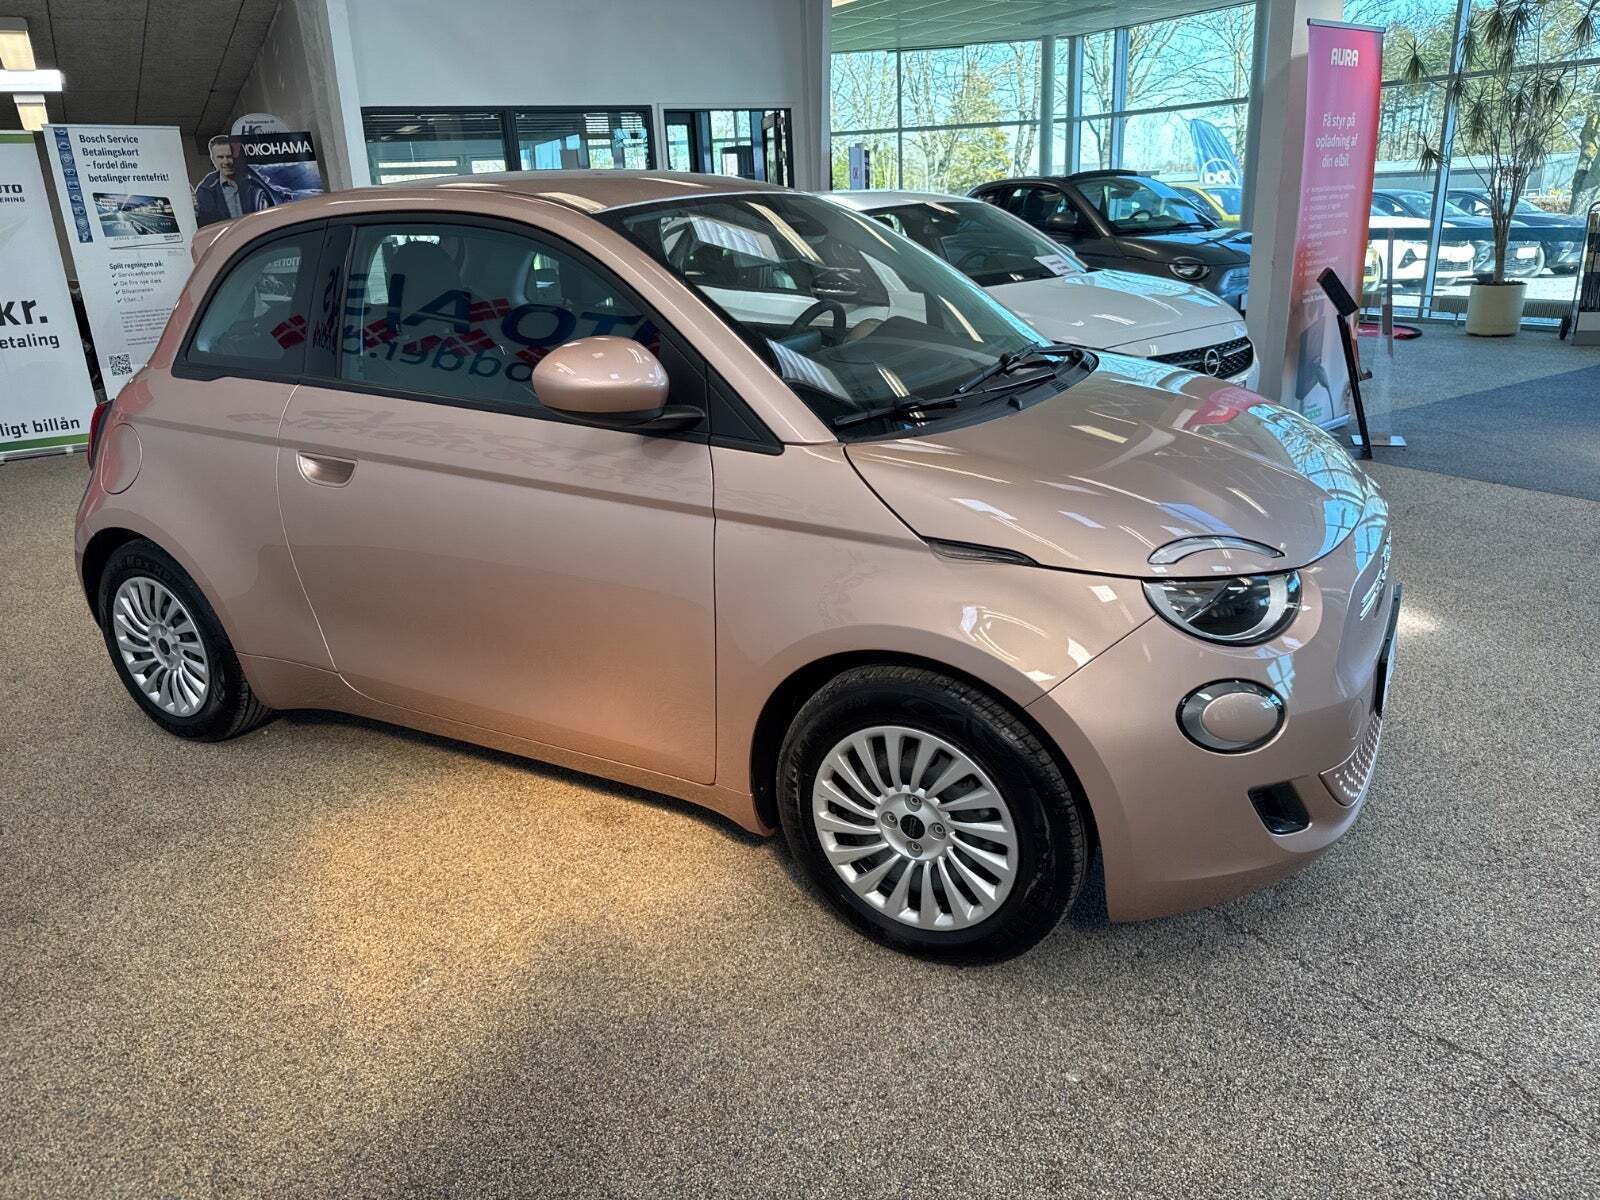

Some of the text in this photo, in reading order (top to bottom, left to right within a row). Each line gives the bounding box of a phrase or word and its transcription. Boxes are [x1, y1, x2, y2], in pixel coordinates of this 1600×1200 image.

[1330, 47, 1359, 67] AURA
[79, 134, 139, 144] Bosch Service
[82, 147, 140, 158] Betalingskort
[241, 140, 313, 157] YOKOHAMA
[92, 161, 118, 170] fordel
[119, 161, 138, 170] dine
[88, 173, 170, 184] betalinger rentefrit!
[125, 261, 153, 271] regningen
[0, 299, 49, 327] kr.
[0, 333, 60, 350] etaling
[32, 417, 80, 434] billån
